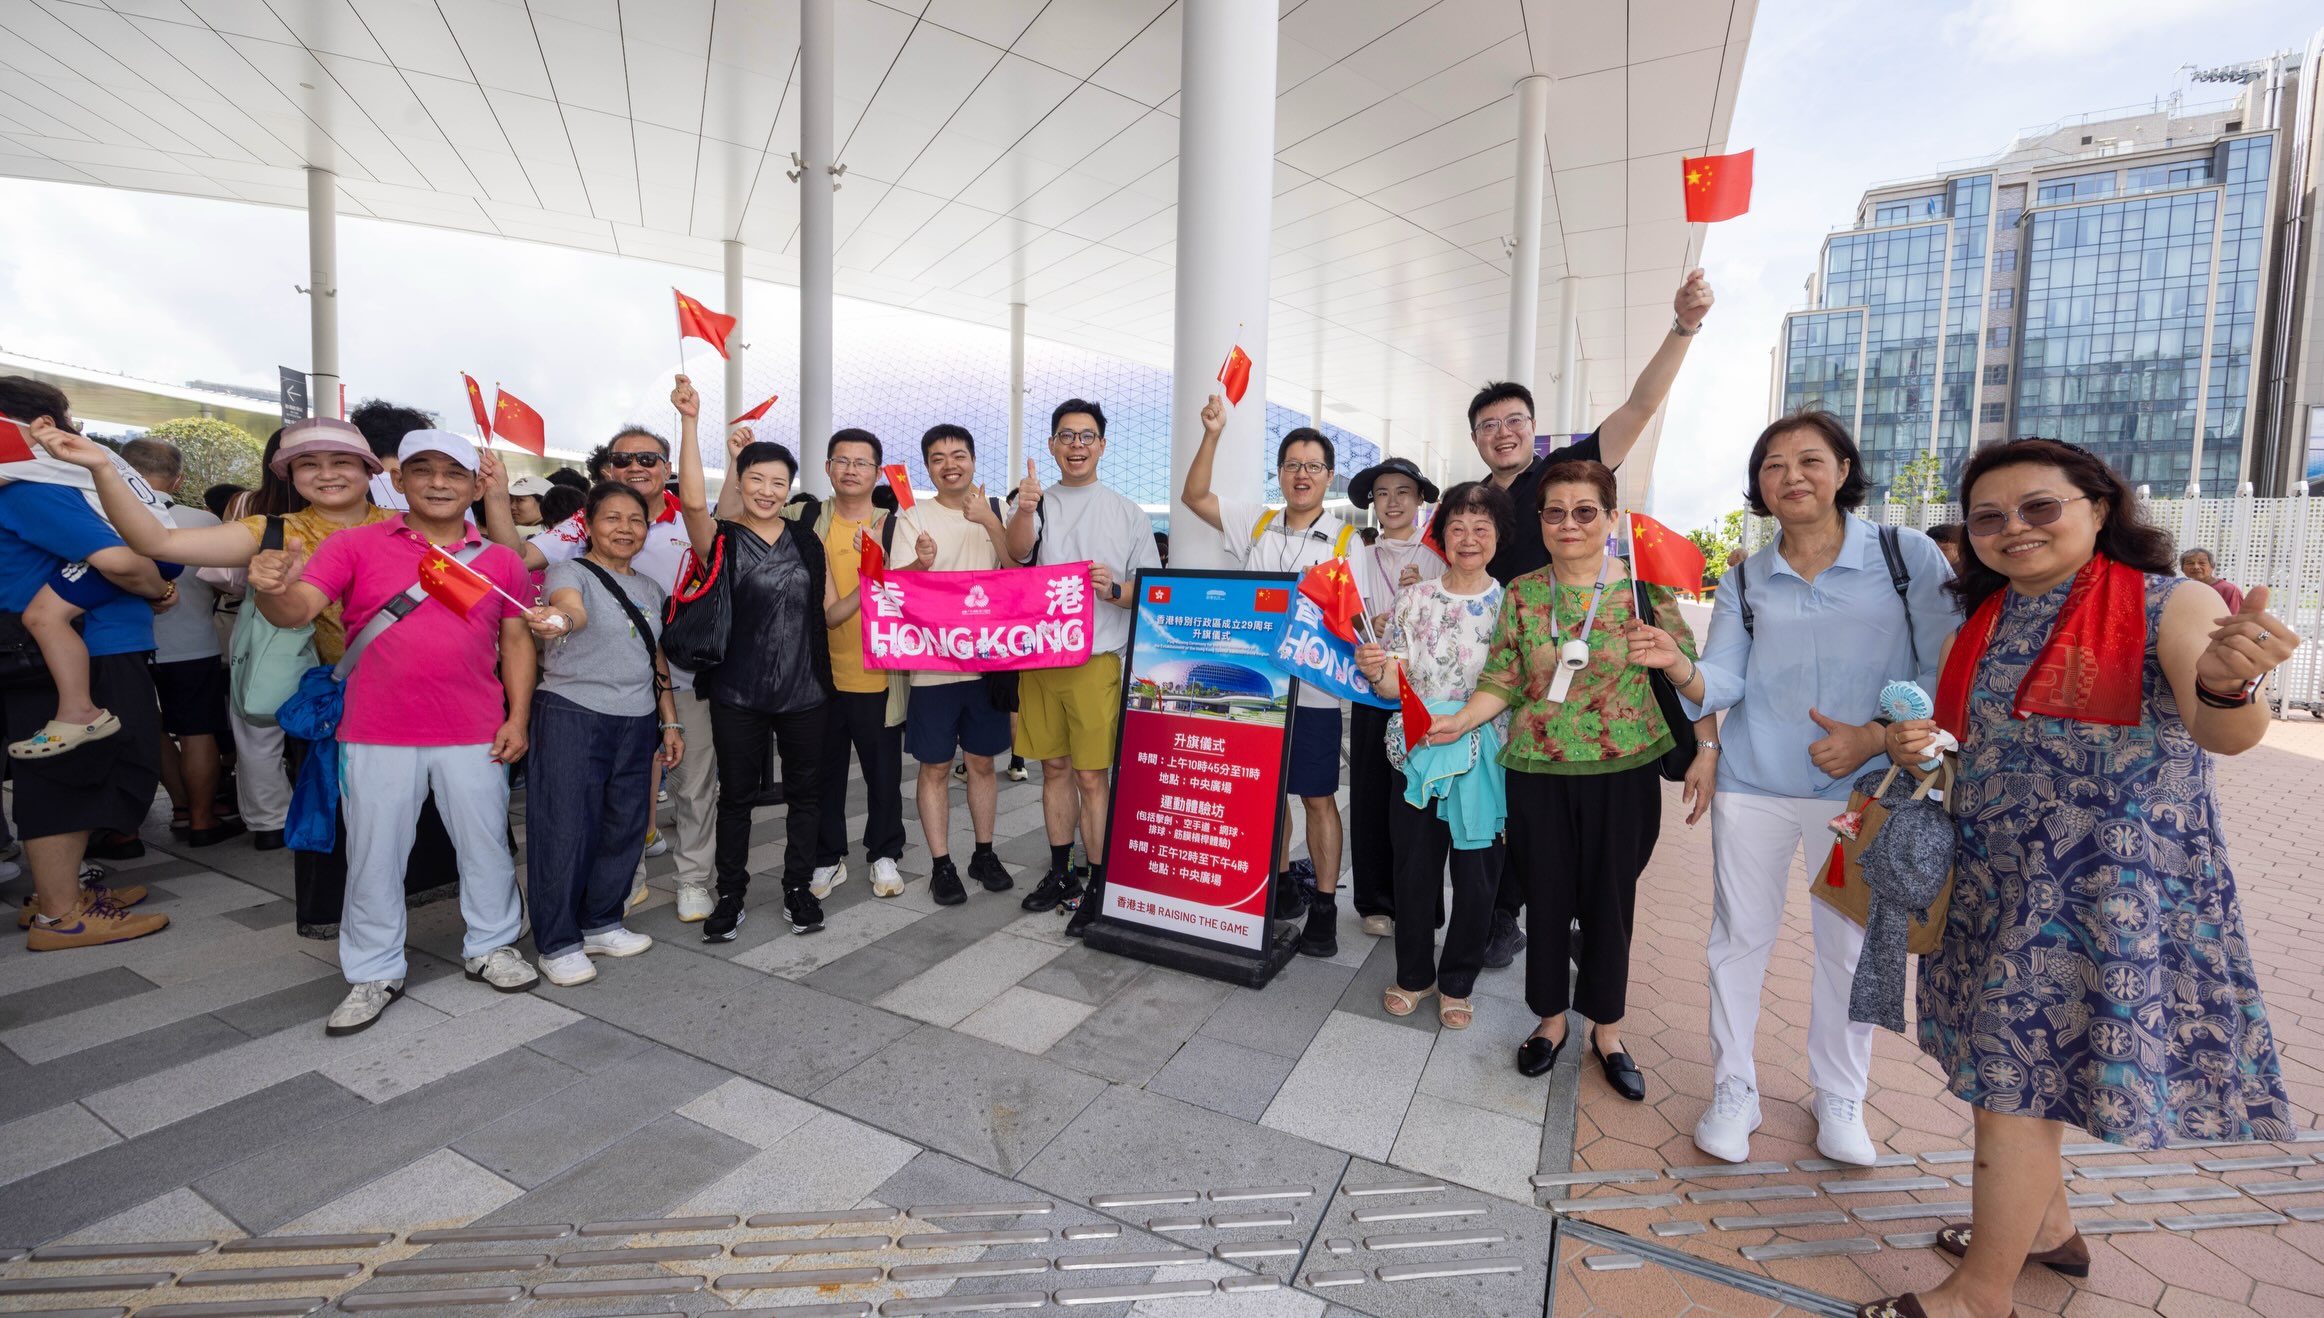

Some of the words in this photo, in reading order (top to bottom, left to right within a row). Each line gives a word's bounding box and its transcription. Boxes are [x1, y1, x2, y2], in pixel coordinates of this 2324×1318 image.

[870, 579, 905, 619] 香
[1045, 575, 1085, 616] 港
[1156, 614, 1274, 632] 香港特別行政區成立29周年
[1192, 628, 1231, 641] 升旗儀式
[870, 620, 974, 660] HONG
[977, 618, 1085, 658] KONG
[1173, 733, 1226, 753] 升旗儀式
[1160, 794, 1225, 819] 運動體驗坊
[1116, 895, 1156, 916] 香港主場
[1158, 906, 1197, 924] RAISING
[1199, 915, 1218, 930] THE
[1220, 921, 1249, 936] GAME
